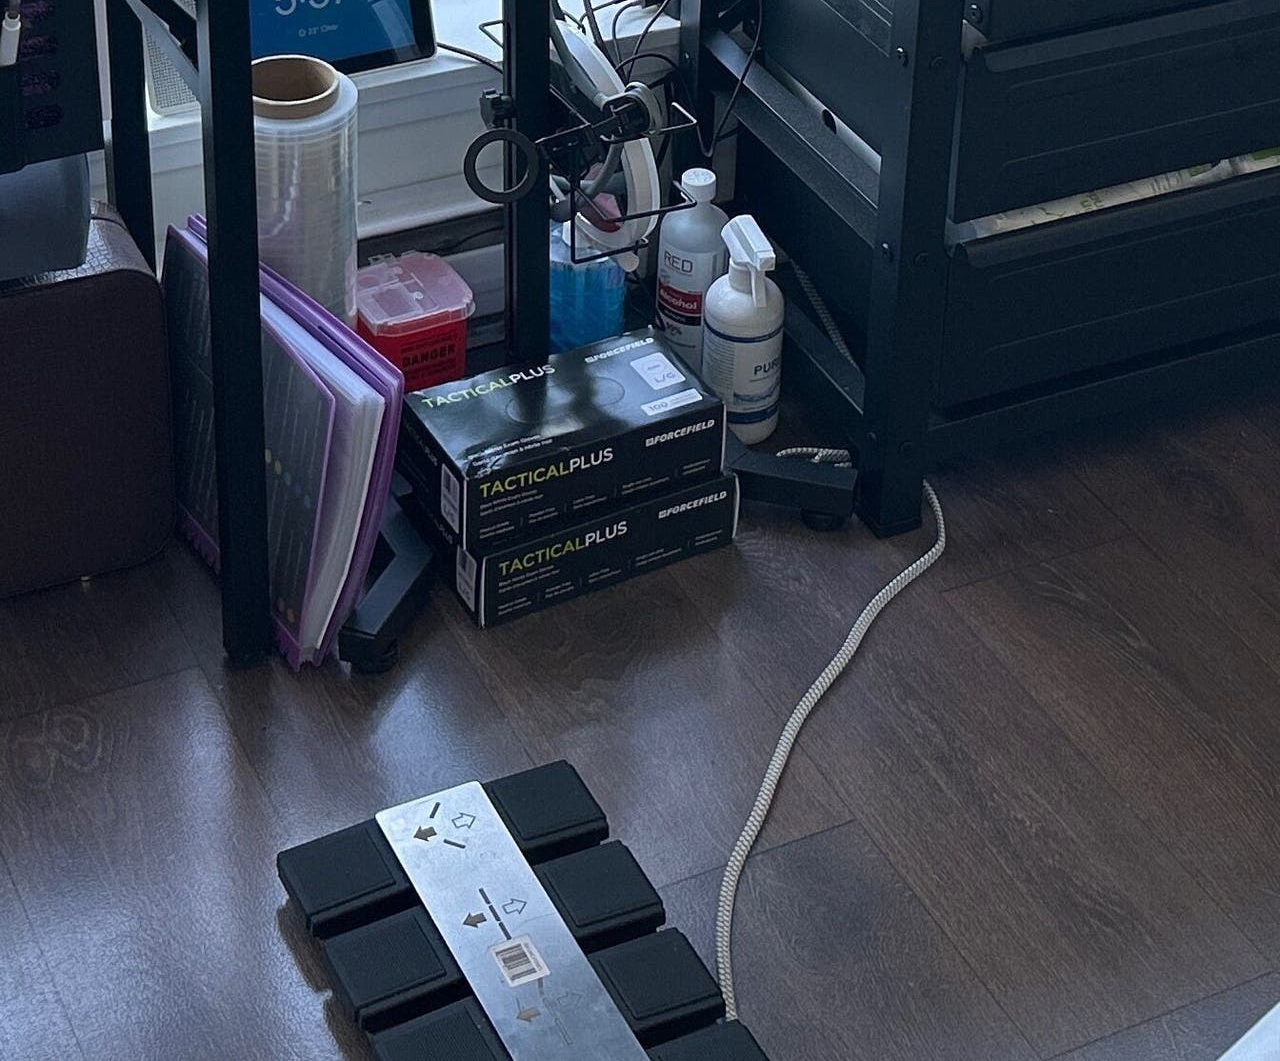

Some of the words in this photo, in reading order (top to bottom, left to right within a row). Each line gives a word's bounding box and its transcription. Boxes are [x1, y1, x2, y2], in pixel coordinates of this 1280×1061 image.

[663, 250, 693, 274] RED
[401, 343, 457, 368] DANGER
[591, 337, 654, 360] FORCEFIELD
[421, 363, 556, 409] TACTICALPLUS
[654, 419, 715, 444] FORCEFIELD
[480, 447, 614, 498] TACTICALPLUS
[666, 490, 727, 516] FORCEFIELD
[498, 520, 628, 576] TACTICALPLUS
